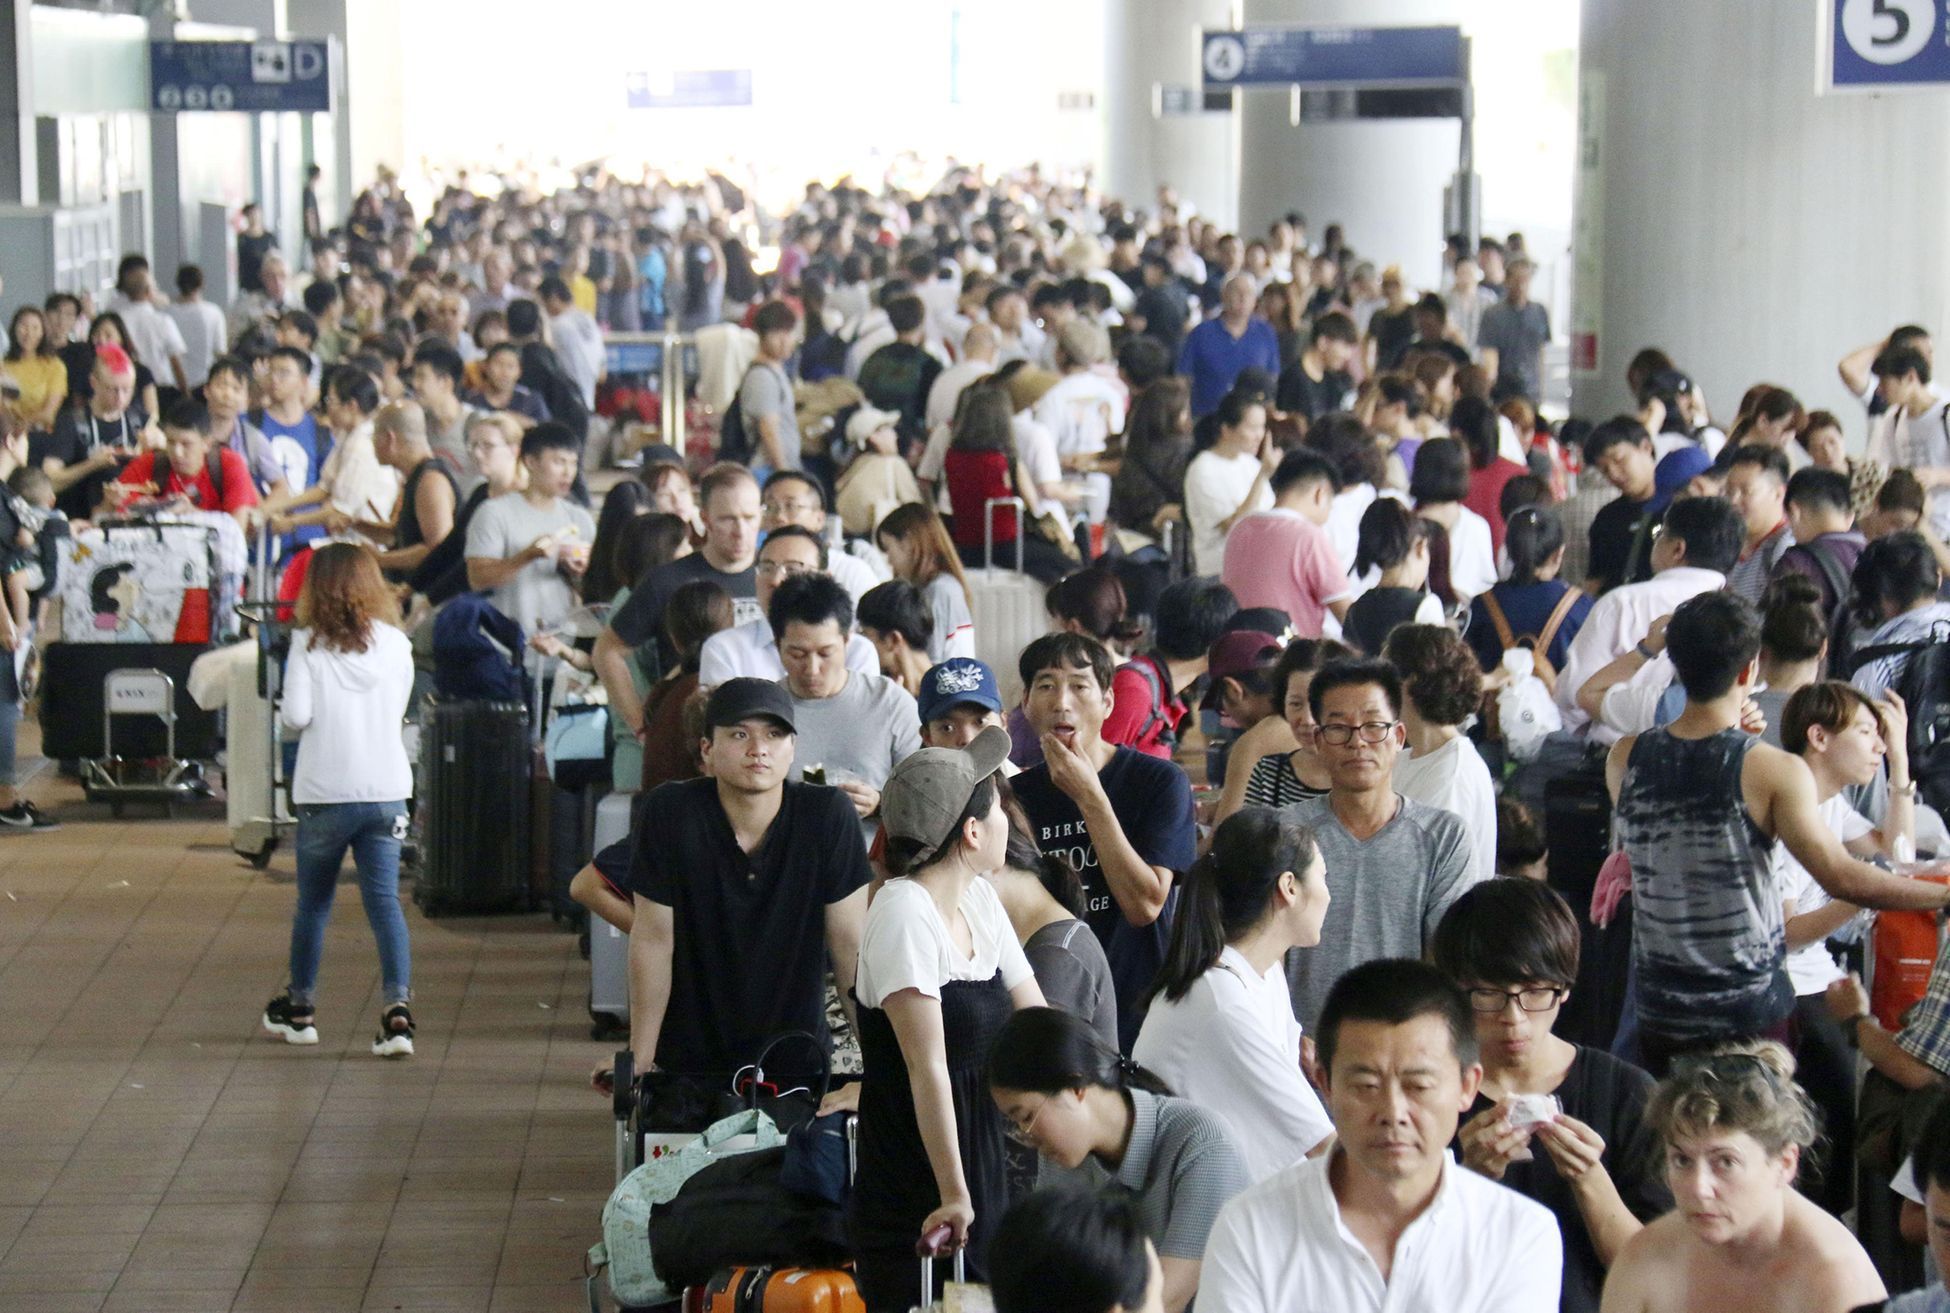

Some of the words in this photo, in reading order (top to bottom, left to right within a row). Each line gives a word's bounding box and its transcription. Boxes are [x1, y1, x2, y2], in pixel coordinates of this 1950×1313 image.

[1870, 0, 1910, 46] 5
[294, 44, 323, 80] D
[1042, 820, 1086, 840] BIRK
